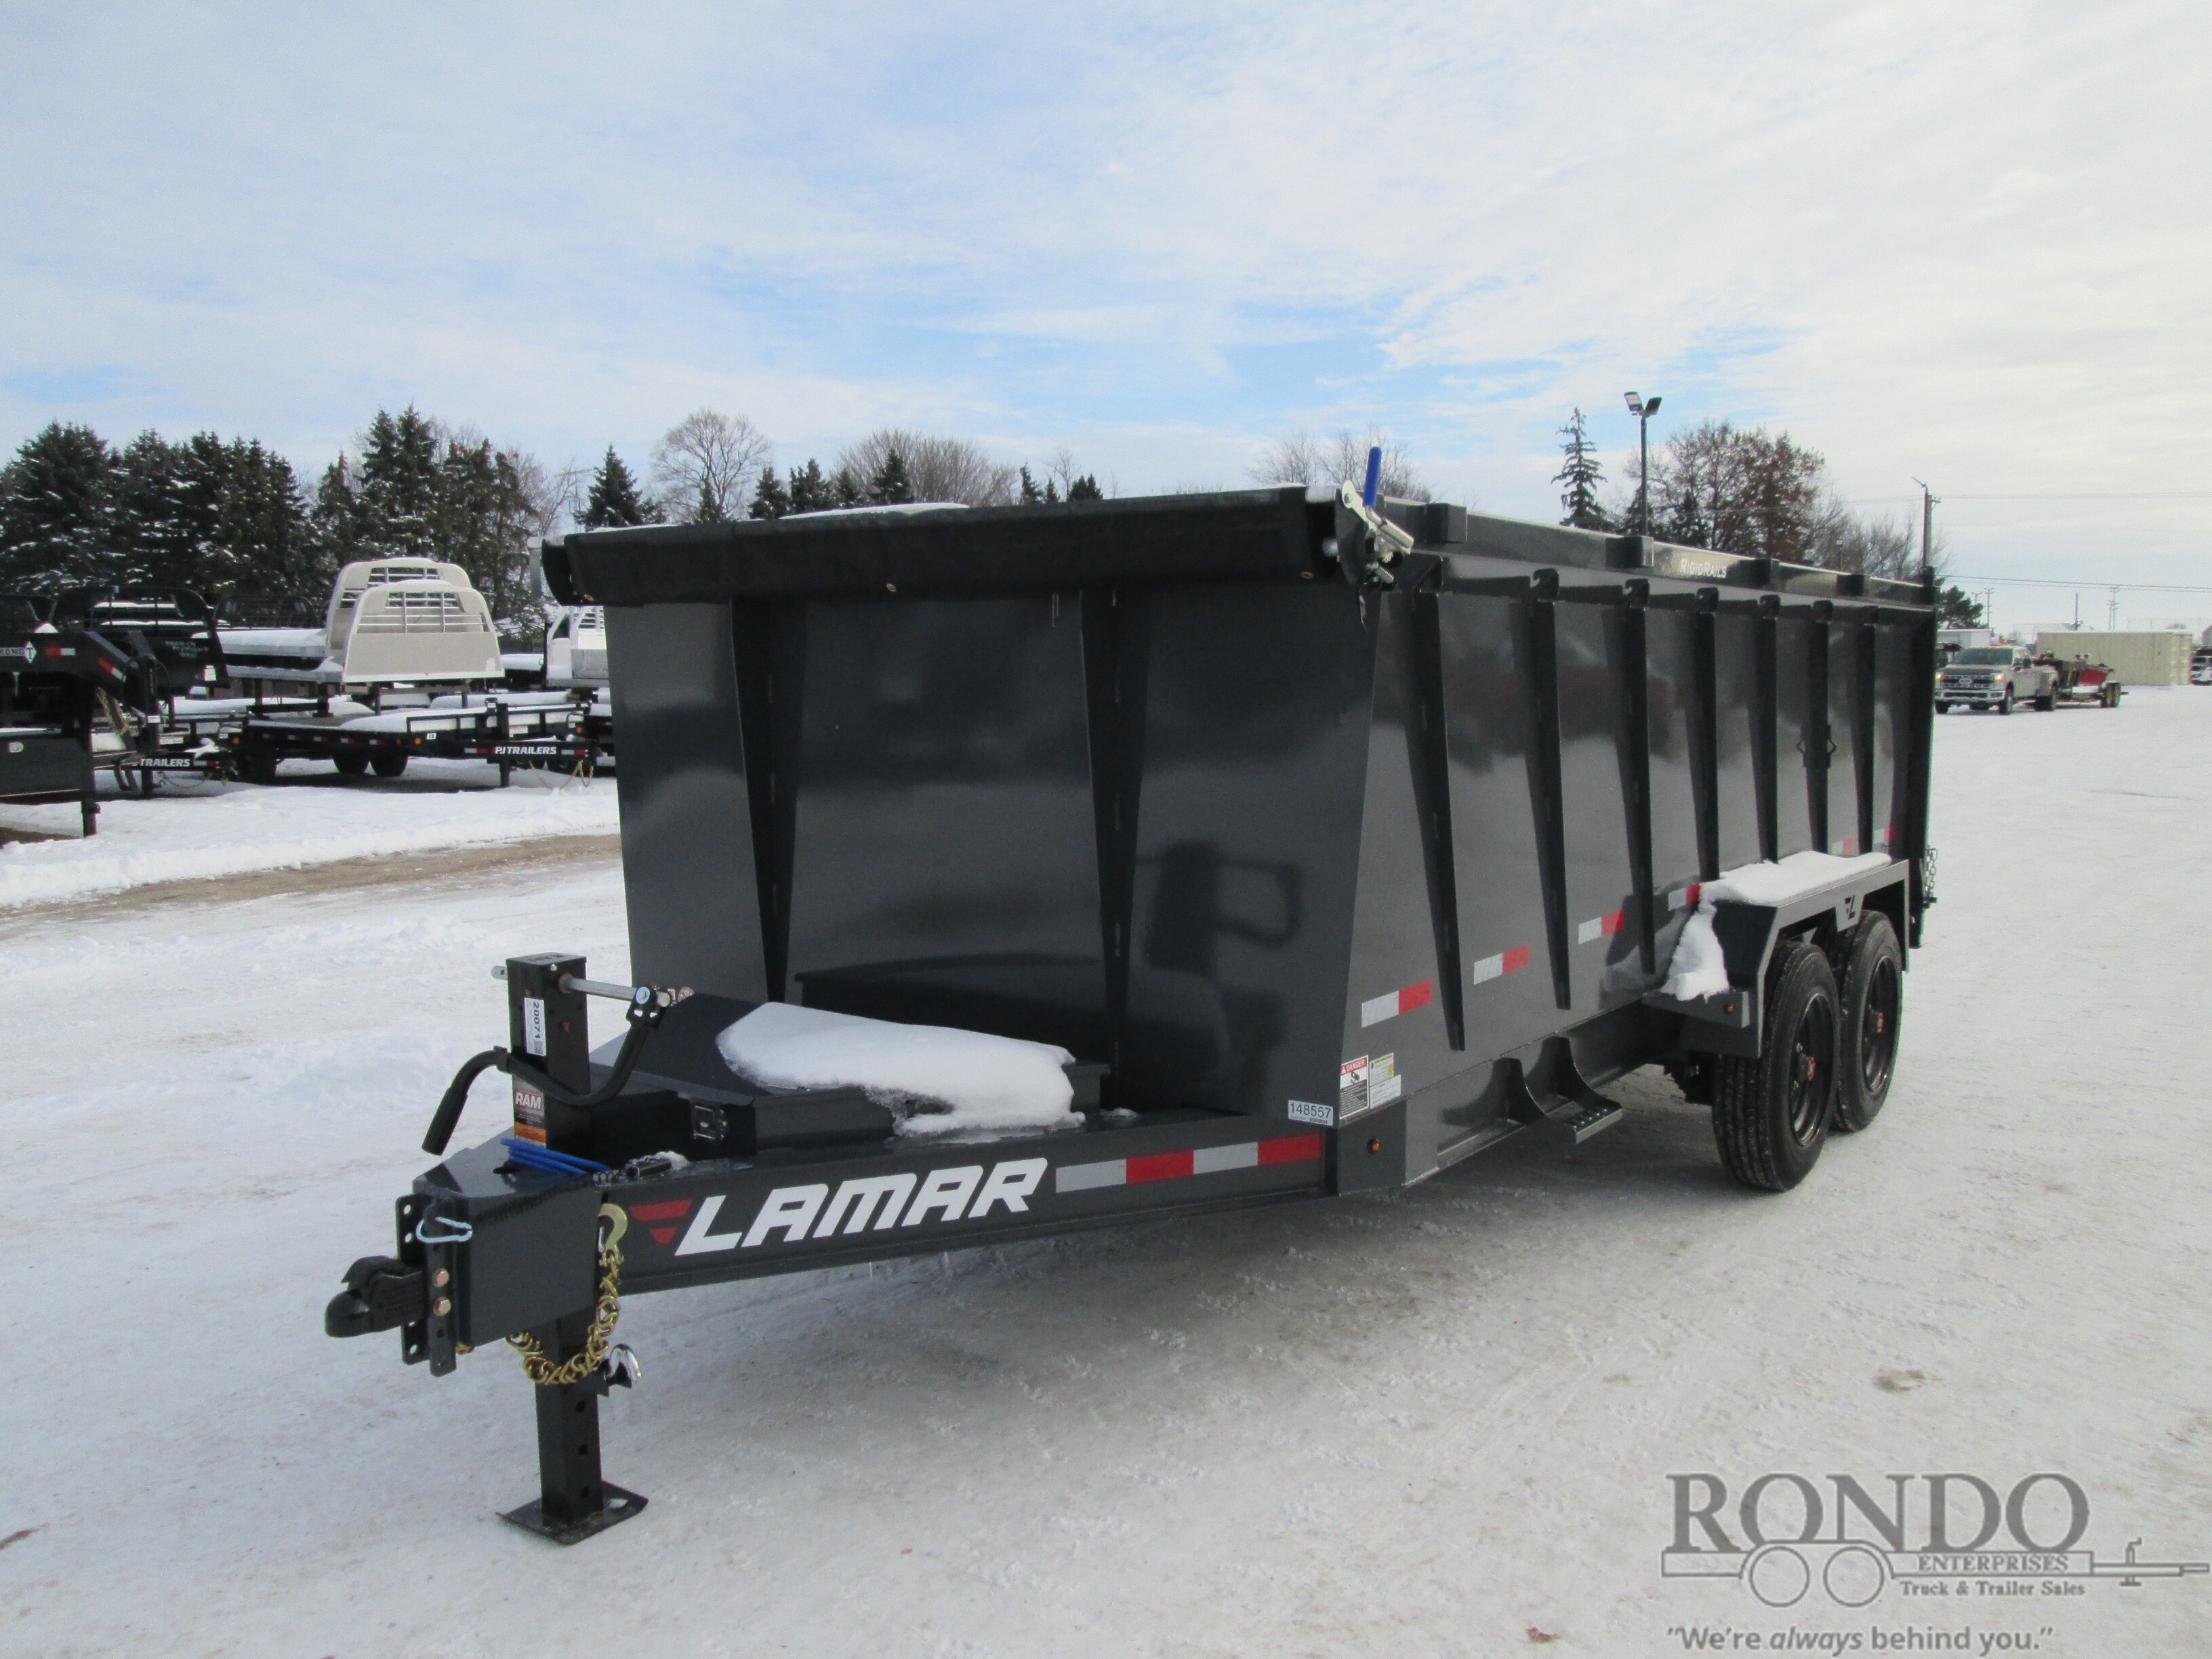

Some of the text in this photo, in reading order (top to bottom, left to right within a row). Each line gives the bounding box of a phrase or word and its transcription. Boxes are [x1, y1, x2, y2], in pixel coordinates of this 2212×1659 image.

[495, 746, 556, 754] PJ TRAILERS
[140, 758, 190, 766] TRAILERS
[1346, 1059, 1365, 1072] DANGER
[516, 1092, 541, 1110] RAM
[1290, 1103, 1331, 1118] 148557
[675, 1158, 1048, 1256] LAMAR
